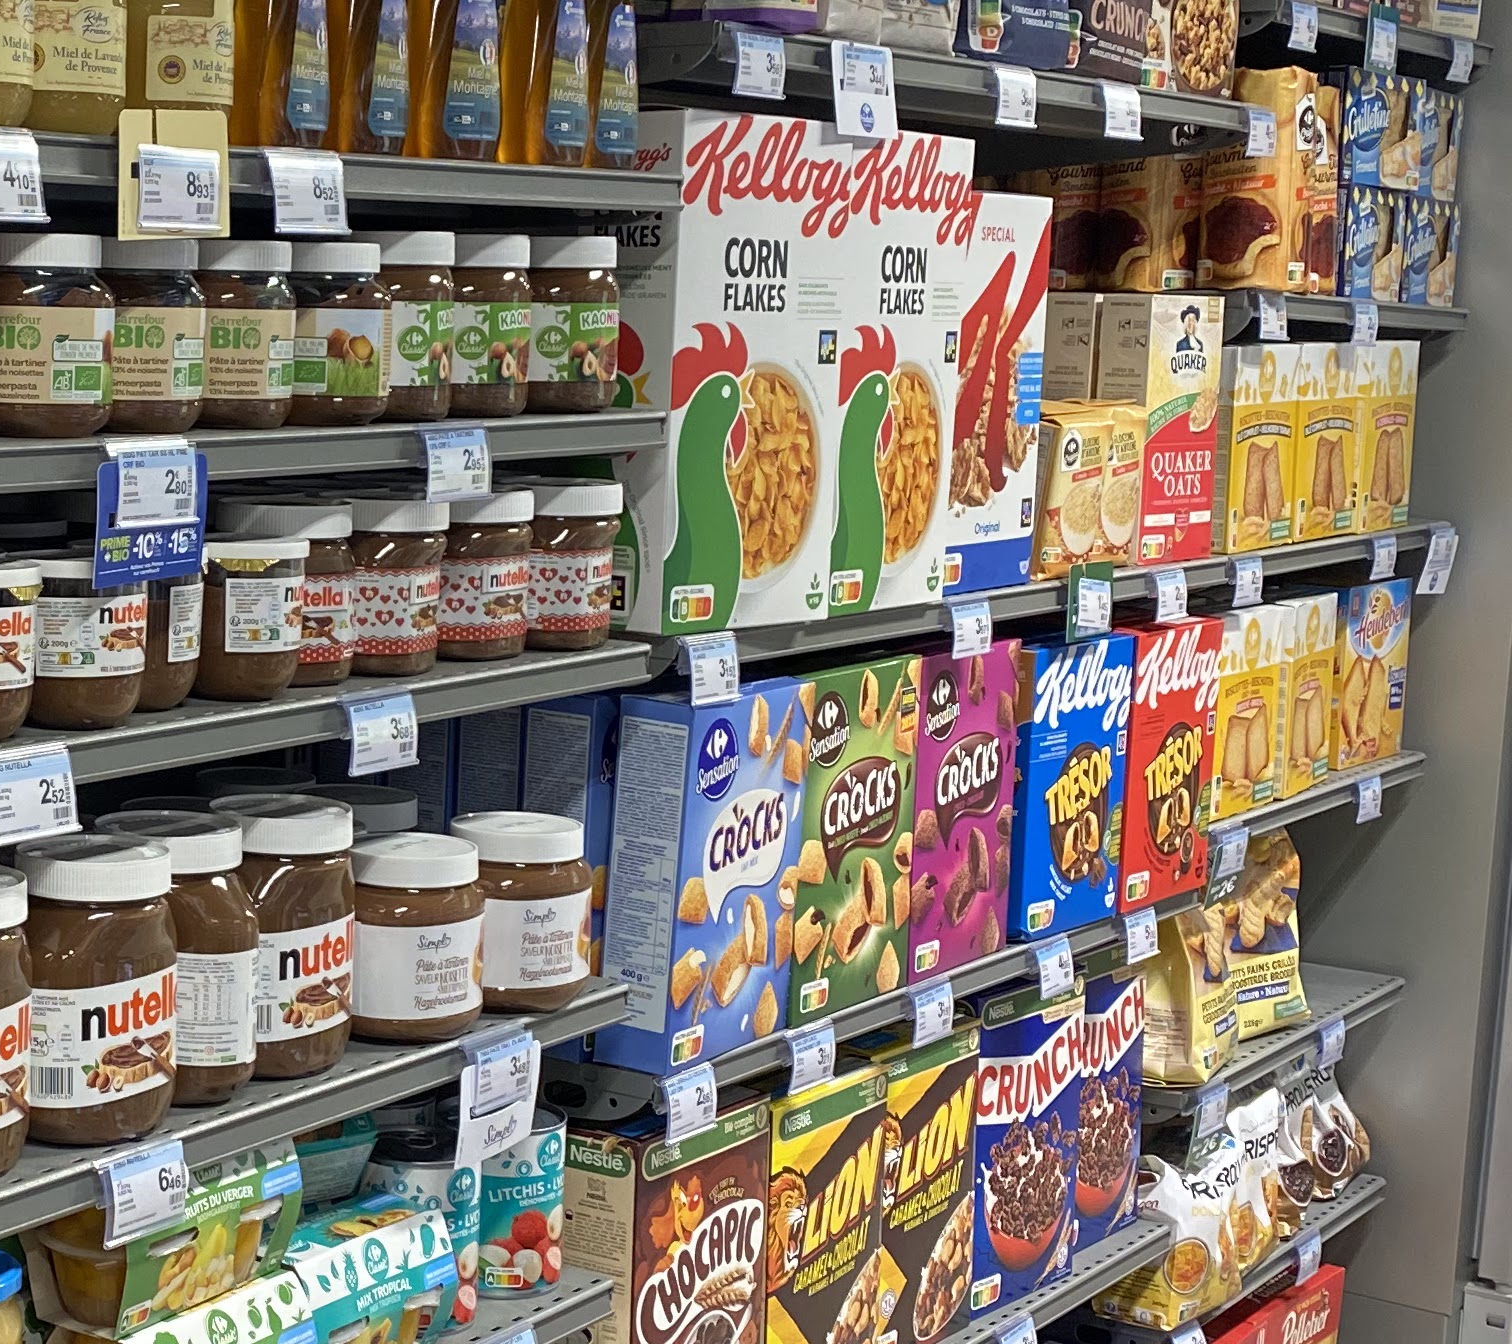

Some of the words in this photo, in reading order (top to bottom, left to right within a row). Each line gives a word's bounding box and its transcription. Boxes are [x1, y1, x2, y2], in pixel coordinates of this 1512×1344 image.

[982, 225, 1016, 244] SPECIAL
[724, 237, 788, 280] CORN
[881, 245, 927, 284] CORN
[723, 282, 786, 313] FLAKES
[879, 287, 924, 315] FLAKES
[1170, 352, 1207, 374] QUAKER
[1151, 450, 1212, 477] QUAKER
[1164, 474, 1201, 496] OATS
[490, 566, 529, 589] nutella
[695, 751, 740, 792] Sensation
[937, 737, 1000, 808] CROCKS
[824, 762, 897, 836] CROCKS
[709, 793, 785, 872] CROCKS
[977, 1019, 1084, 1120] CRUNCH
[488, 1184, 543, 1204] LITCHIS
[357, 1293, 375, 1312] MIX
[377, 1277, 413, 1304] TROPICAL
